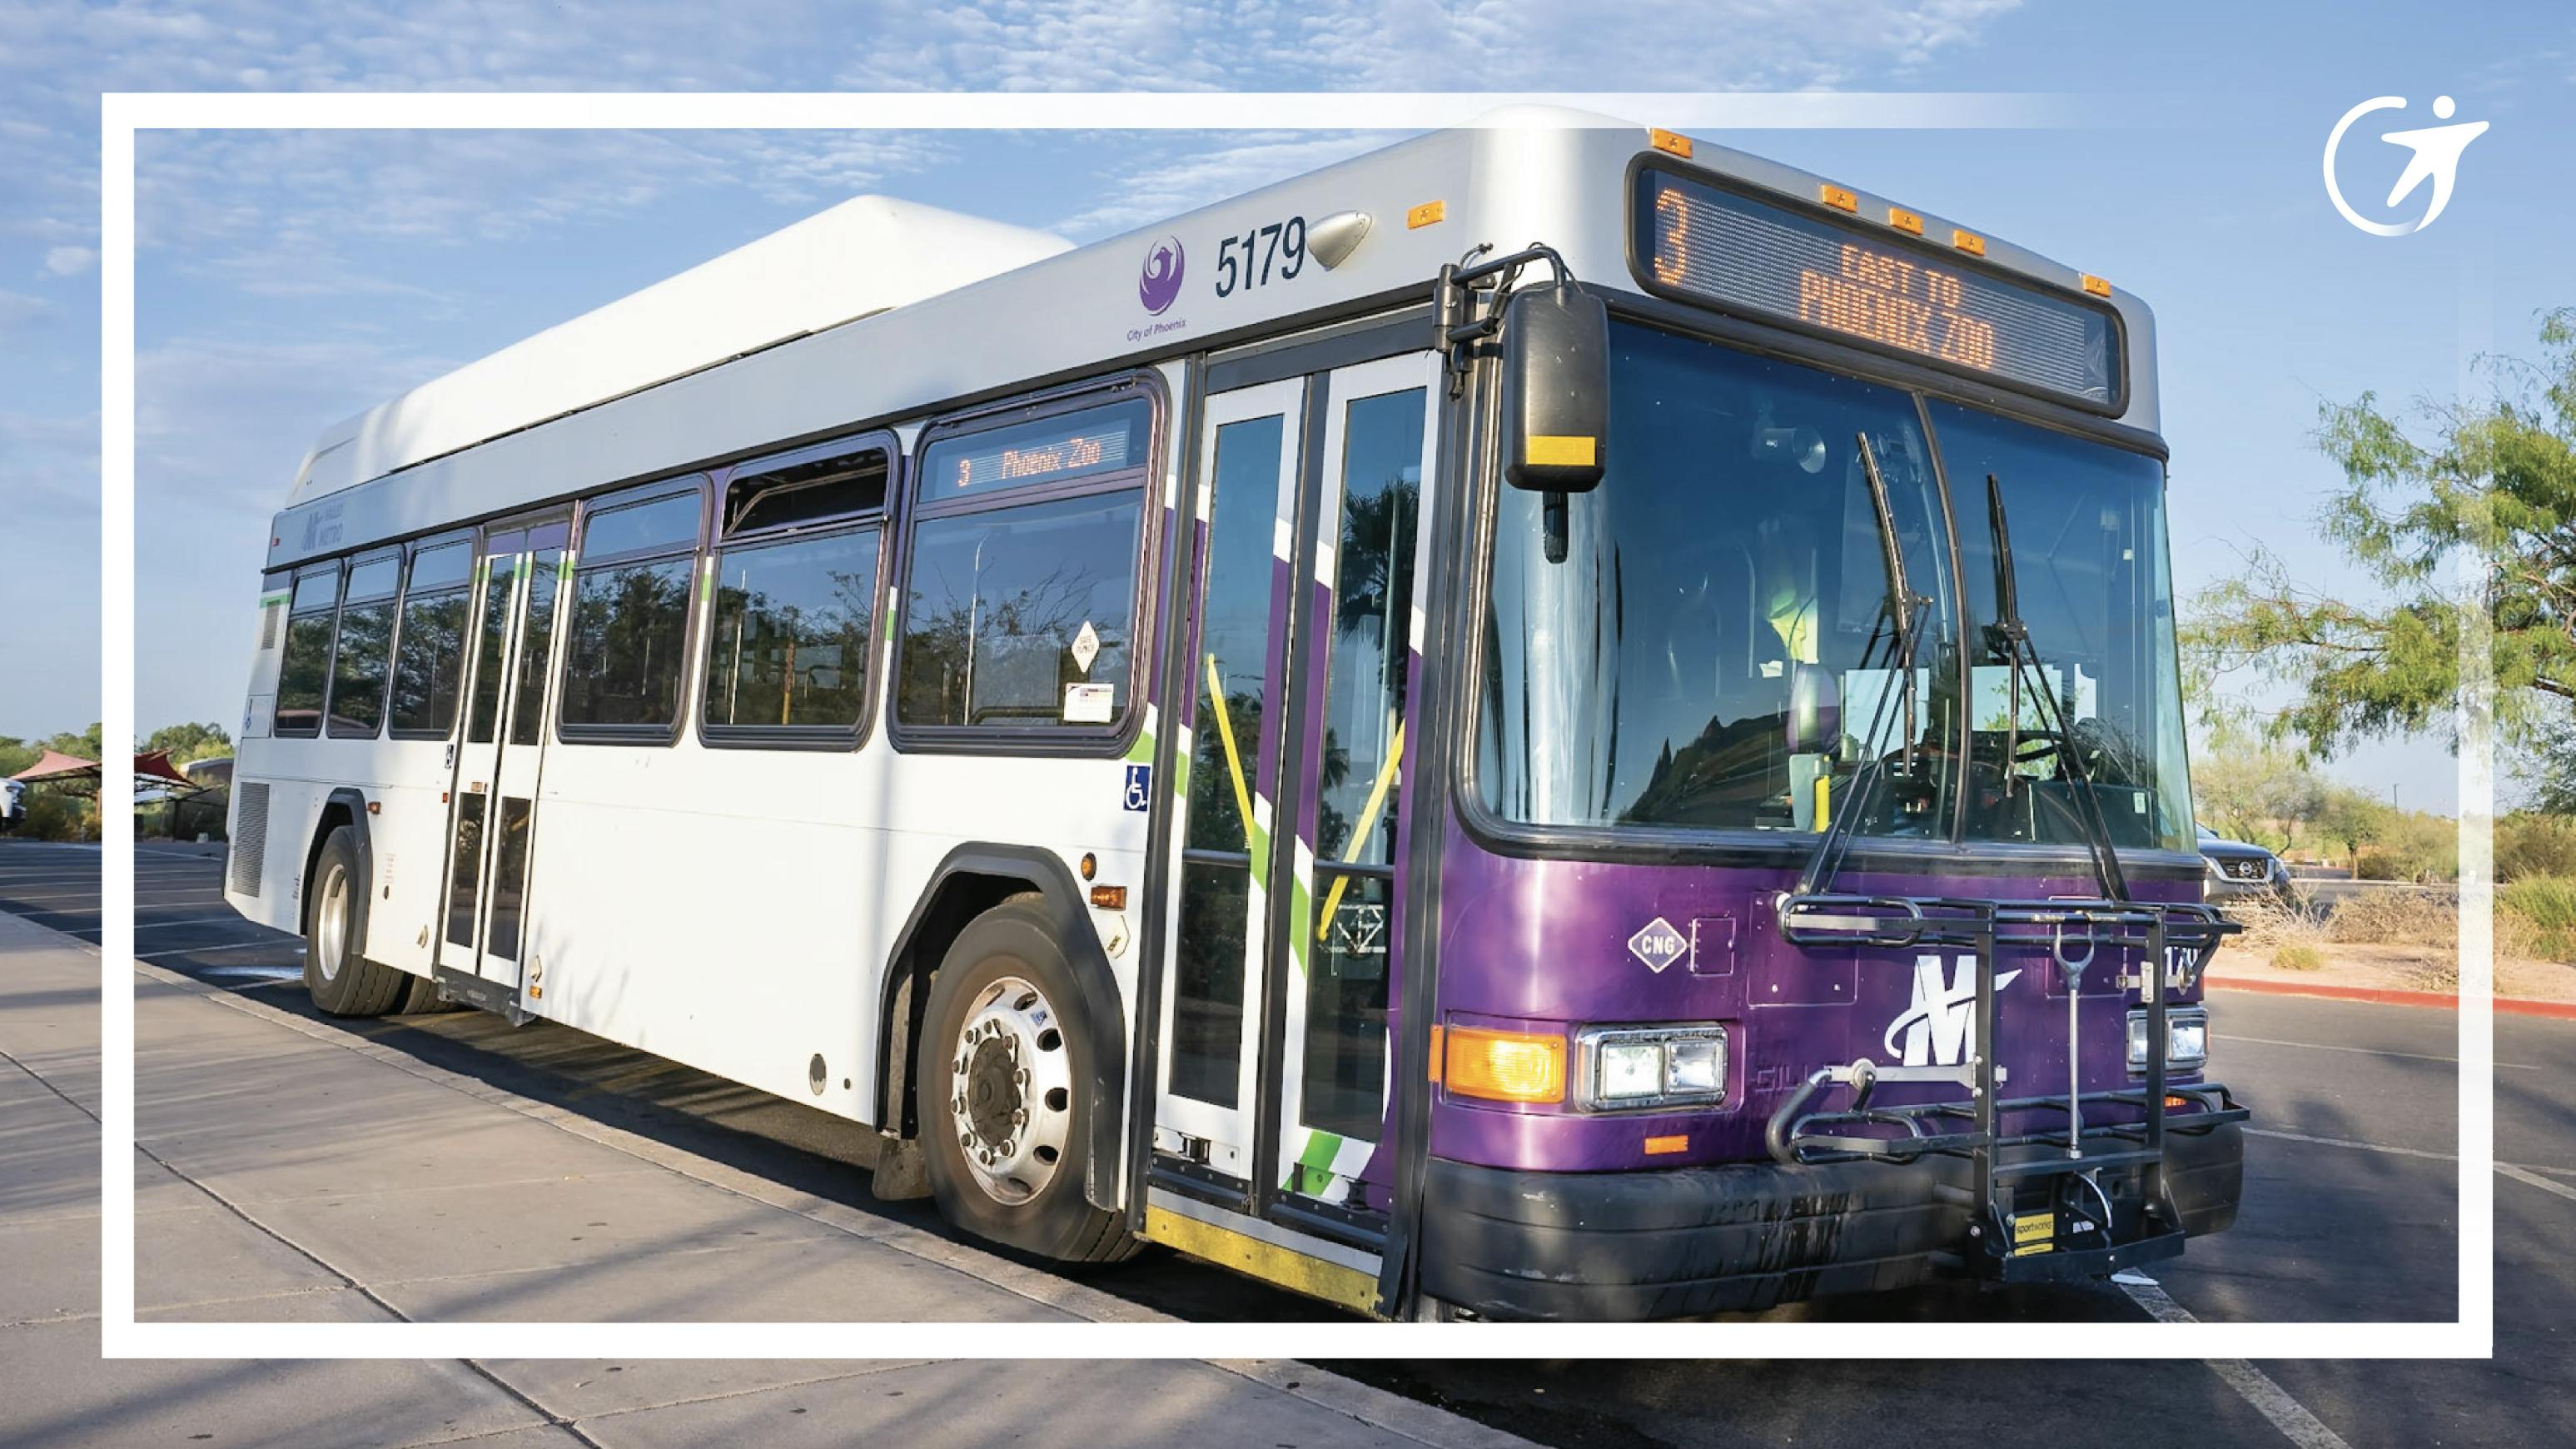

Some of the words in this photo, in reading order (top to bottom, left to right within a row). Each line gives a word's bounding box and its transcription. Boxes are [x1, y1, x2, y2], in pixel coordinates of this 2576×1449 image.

[1216, 216, 1306, 298] 5179
[1654, 187, 1687, 284] 3
[1842, 243, 1914, 294] EAST
[1924, 268, 1960, 308] TO
[1126, 330, 1142, 342] City
[1143, 325, 1153, 336] of
[1154, 319, 1186, 334] Phoenix
[1800, 268, 1932, 354] PHOENIX
[1941, 311, 1993, 369] ZOO
[958, 459, 972, 486] 3
[1002, 446, 1062, 480] Phoenix
[1067, 437, 1102, 469] Zoo
[1641, 935, 1674, 955] CNG
